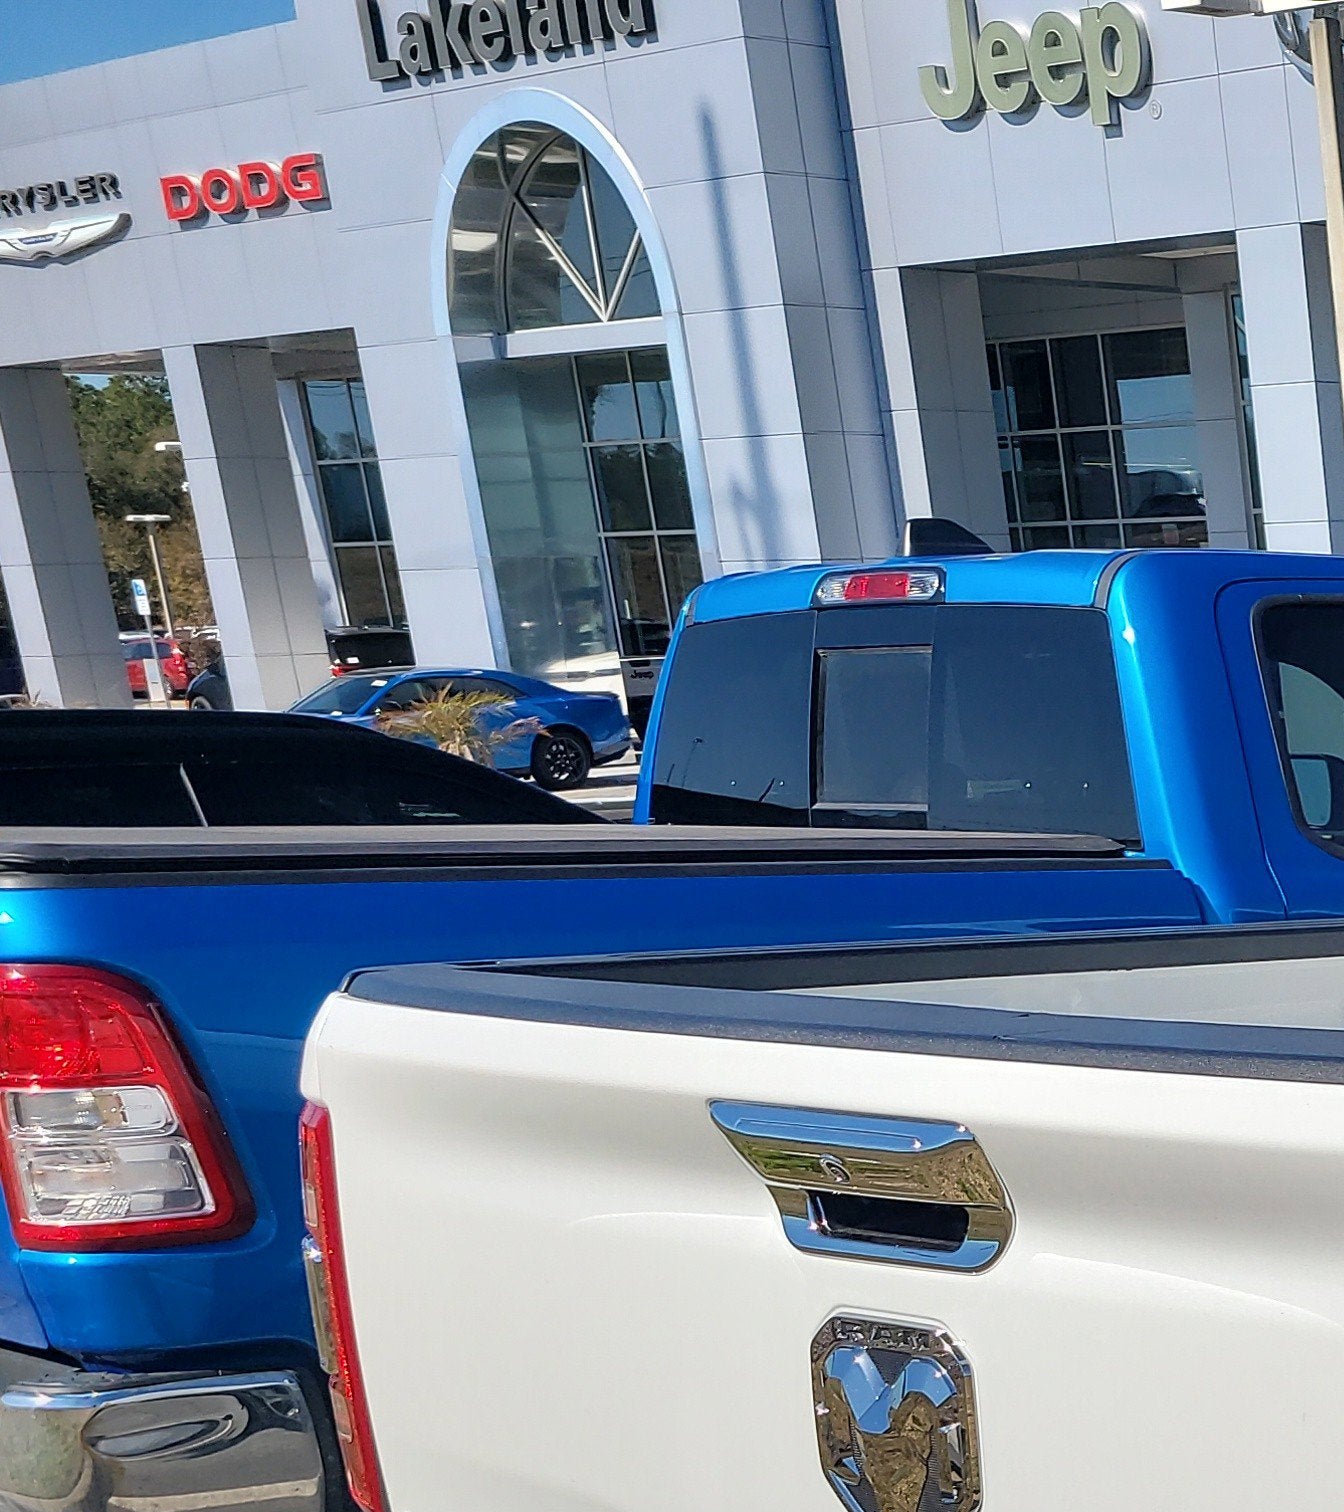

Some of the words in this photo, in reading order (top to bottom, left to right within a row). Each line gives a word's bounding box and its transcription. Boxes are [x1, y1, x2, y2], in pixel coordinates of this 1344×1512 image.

[918, 0, 1142, 126] Jeep
[0, 172, 122, 214] RYSLER
[160, 152, 322, 222] DODG
